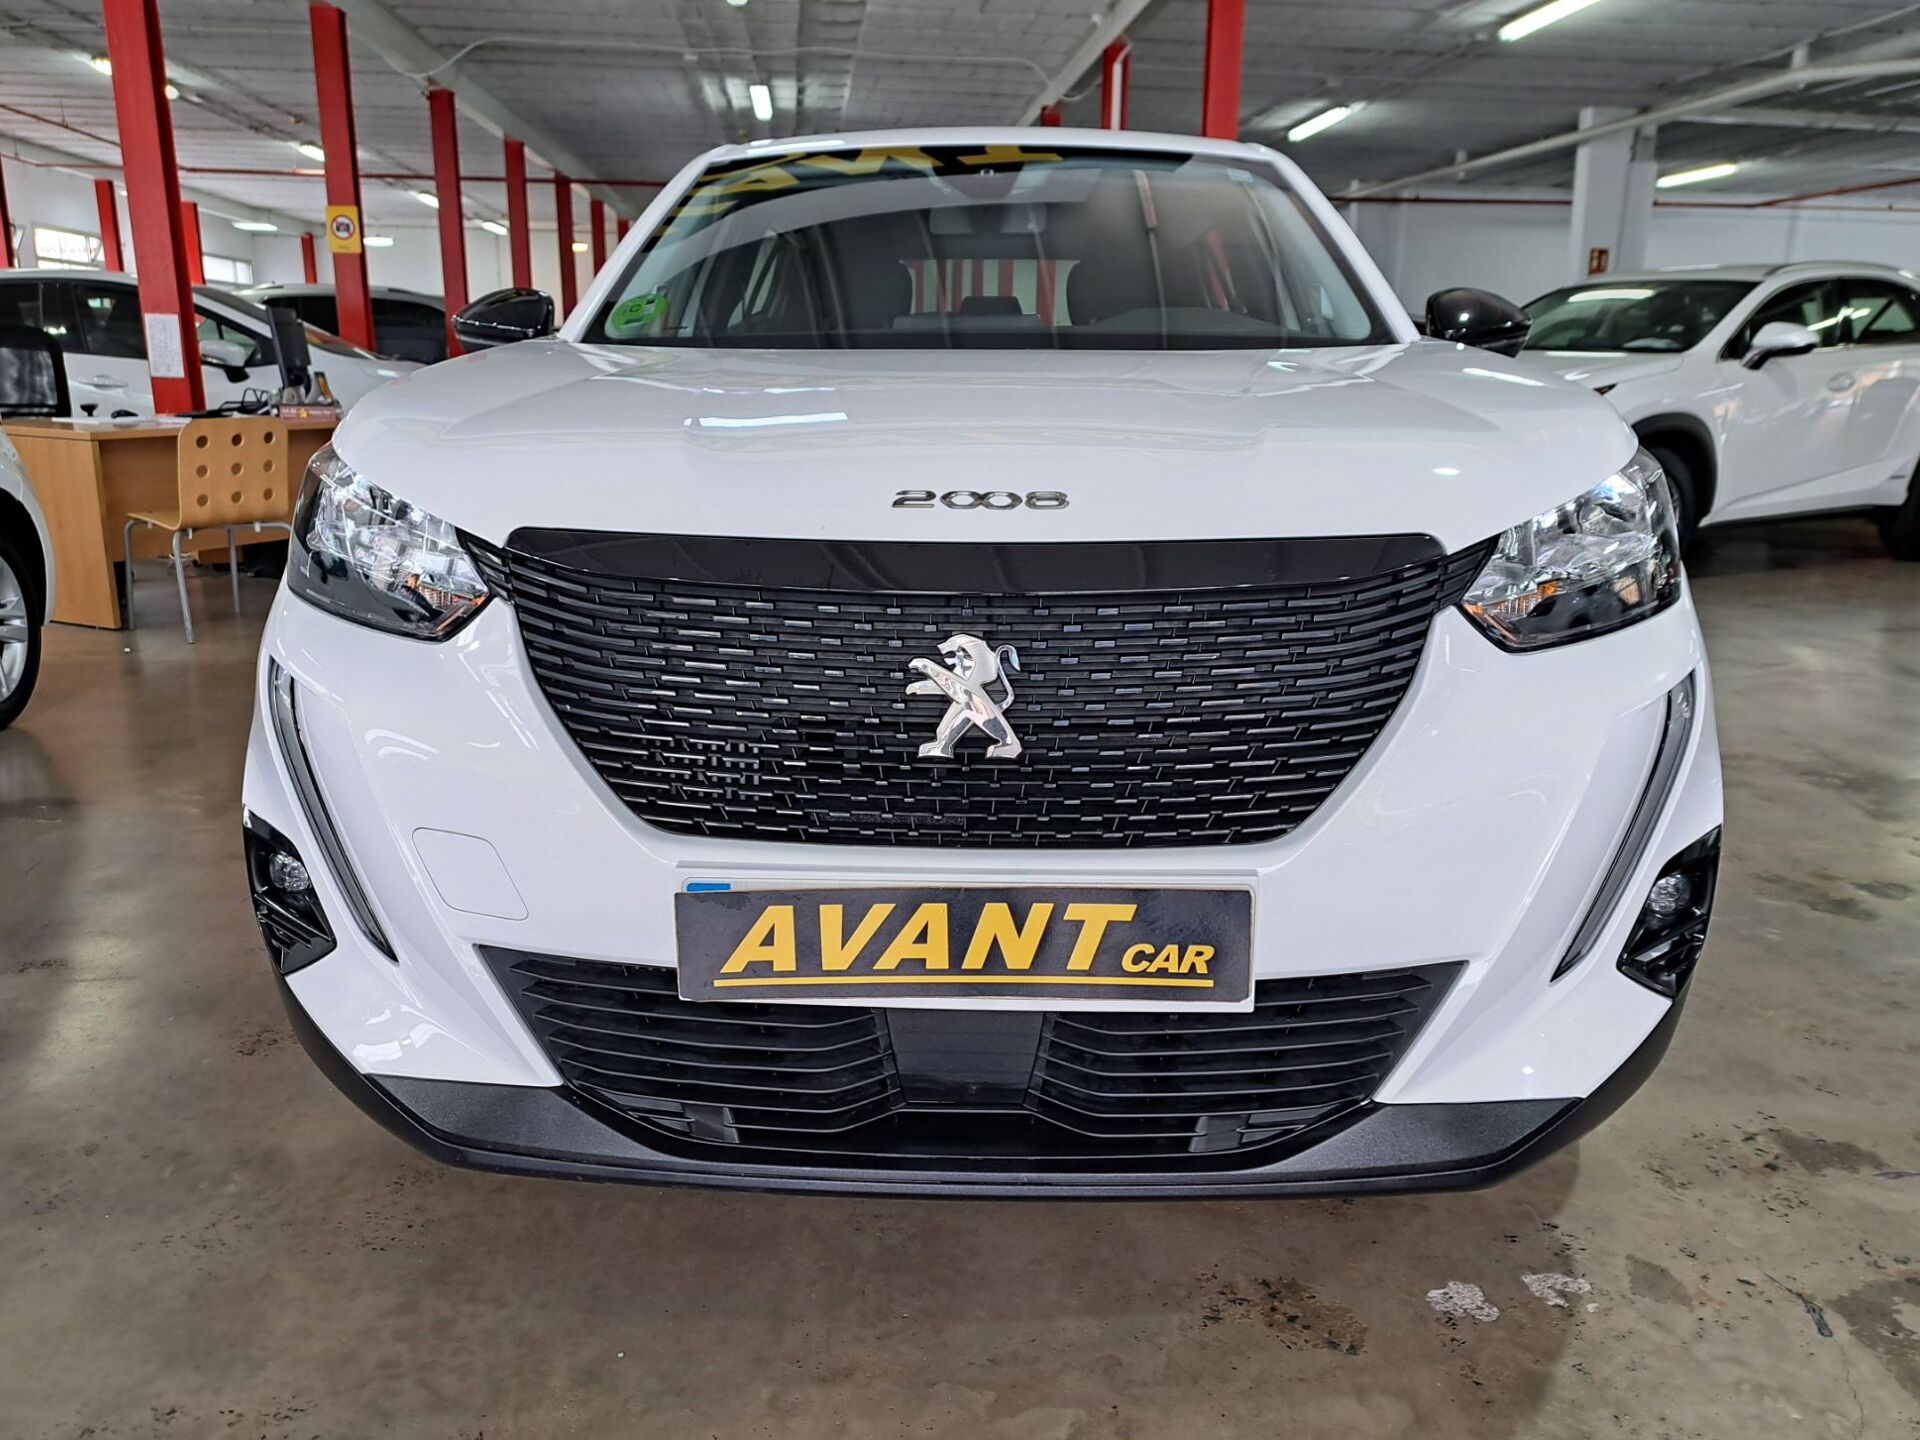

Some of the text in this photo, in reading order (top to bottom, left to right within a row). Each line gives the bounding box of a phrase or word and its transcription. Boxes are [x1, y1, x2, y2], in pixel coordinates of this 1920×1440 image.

[892, 490, 1070, 510] 2008
[720, 902, 1215, 974] AVANT CAR
